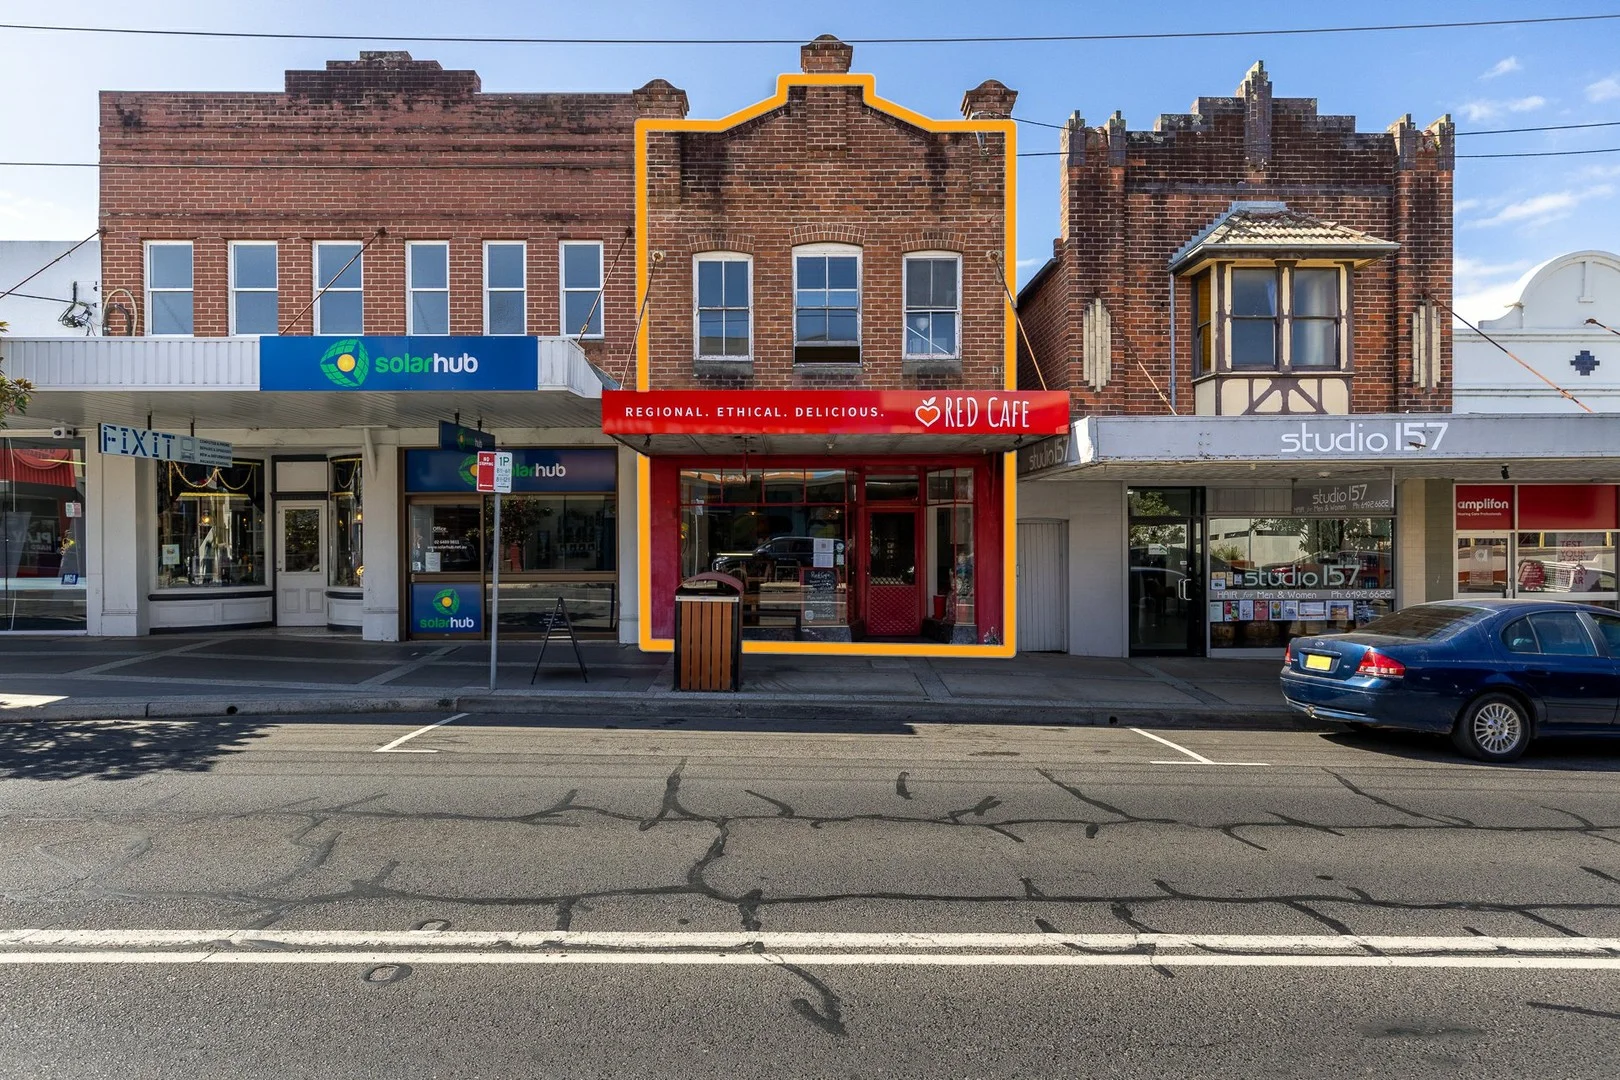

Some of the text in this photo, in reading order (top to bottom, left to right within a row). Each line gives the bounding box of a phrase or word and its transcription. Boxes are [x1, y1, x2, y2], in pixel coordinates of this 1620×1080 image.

[375, 353, 478, 373] solarhub
[625, 407, 885, 417] REGIONAL. ETHICAL. DELICIOUS.
[945, 397, 1030, 428] RED CAFE
[103, 424, 175, 459] FIXIT
[1281, 422, 1449, 452] studio 157
[499, 456, 510, 466] 1P
[1029, 442, 1054, 470] studio
[512, 462, 566, 477] larhub
[1312, 484, 1368, 505] studio 157
[1457, 498, 1509, 512] amplifon
[1244, 564, 1318, 587] studio
[1323, 564, 1361, 586] 157
[1217, 591, 1238, 599] HAIR
[1257, 591, 1274, 599] Men
[1277, 591, 1285, 599] &
[1287, 591, 1317, 599] Women
[1345, 590, 1367, 599] 6492
[1368, 590, 1391, 599] 6622
[420, 617, 475, 628] solarhub
